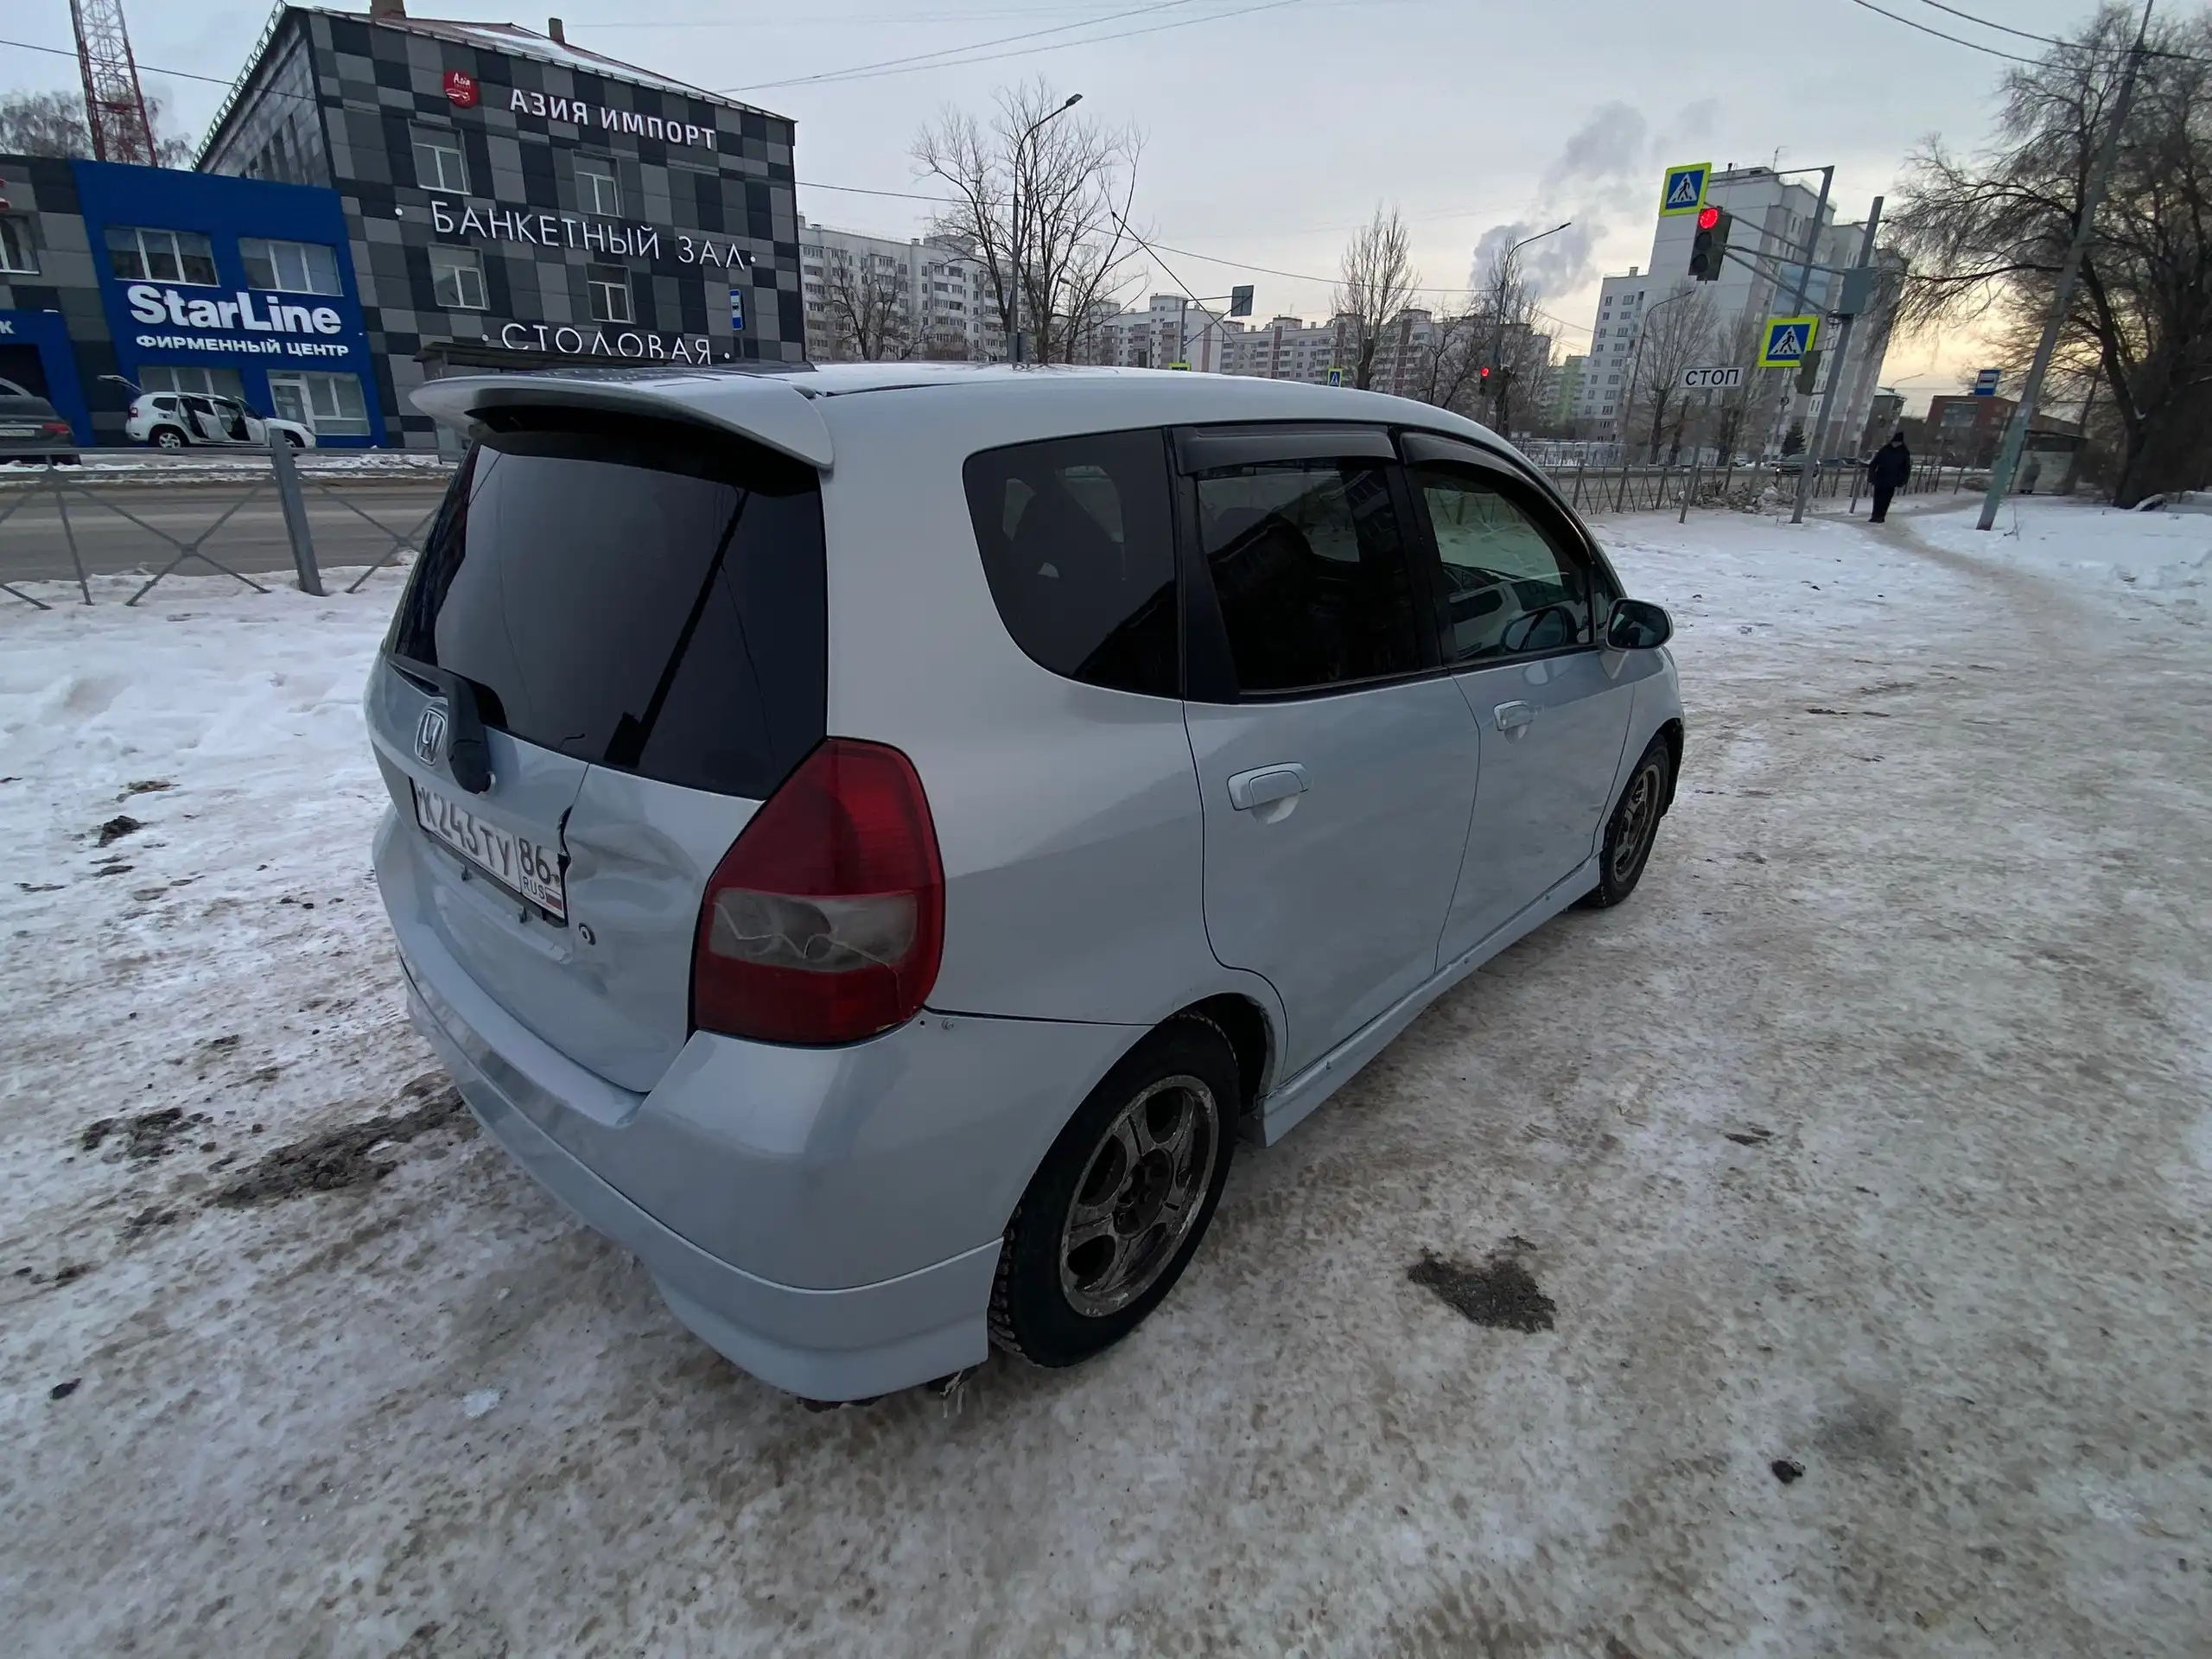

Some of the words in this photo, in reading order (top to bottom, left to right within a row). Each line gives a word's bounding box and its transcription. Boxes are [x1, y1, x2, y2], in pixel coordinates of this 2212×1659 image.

[510, 88, 588, 124] АЗИЯ
[601, 106, 715, 149] ИМПОРТ
[431, 200, 660, 259] БАНКЕТНЫЙ
[677, 235, 745, 270] ЗАЛ
[127, 284, 341, 335] StarLine
[136, 334, 282, 353] ФИРМЕННЫЙ
[287, 342, 349, 357] ЦЕНТР
[501, 323, 711, 365] СТОЛОВАЯ
[1685, 369, 1739, 386] СТОП
[518, 837, 551, 886] 86
[522, 876, 545, 899] RUS
